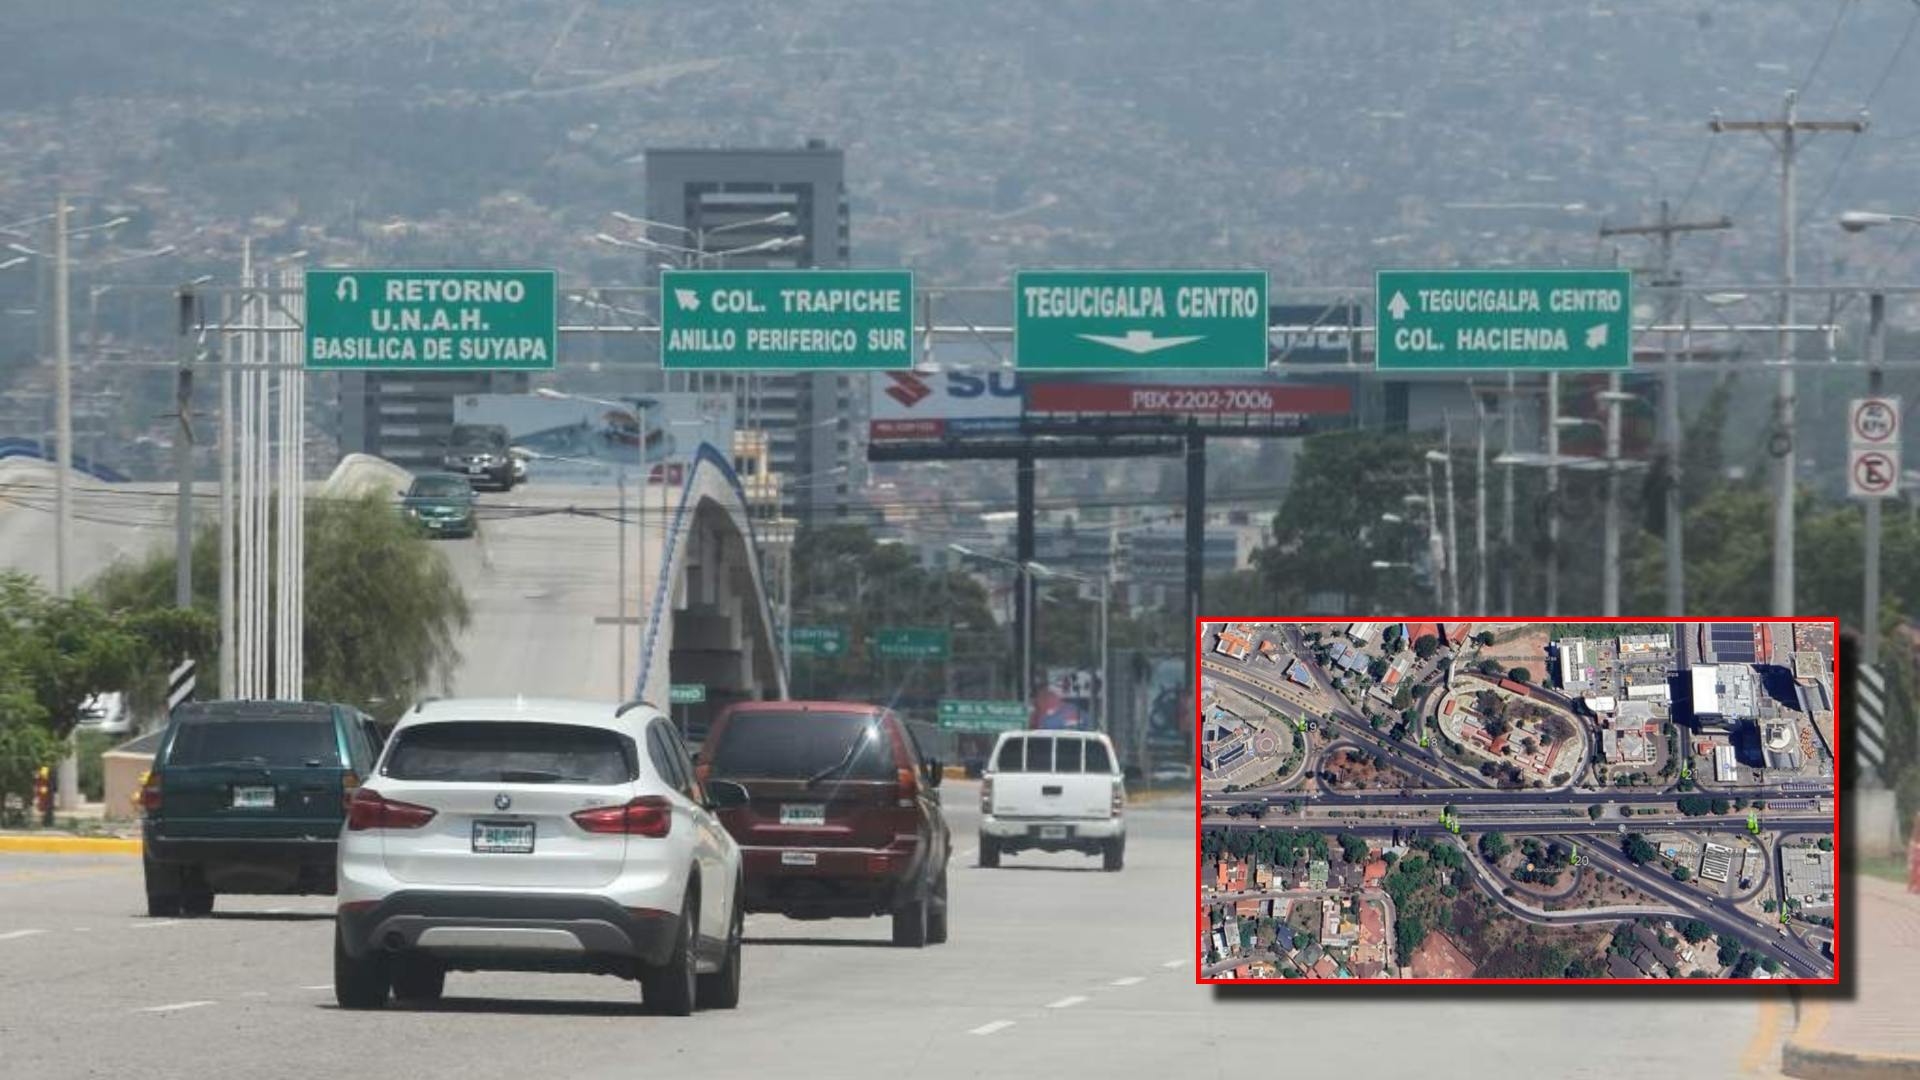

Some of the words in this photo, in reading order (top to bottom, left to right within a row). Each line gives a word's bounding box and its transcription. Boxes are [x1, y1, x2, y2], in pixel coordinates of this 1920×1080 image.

[386, 279, 525, 303] RETORNO
[711, 289, 767, 313] COL.
[780, 289, 902, 313] TRAPICHE
[1024, 286, 1167, 318] TEGUCIGALPA
[1176, 286, 1259, 318] CENTRO
[1418, 289, 1540, 313] TEGUCIGALPA
[1549, 288, 1622, 312] CENTRO
[371, 308, 490, 332] U.N.A.H.
[312, 337, 417, 360] BASILICA
[423, 338, 452, 360] DE
[459, 337, 547, 361] SUYAPA
[668, 328, 736, 351] ANILLO
[746, 328, 857, 352] PERIFERICO
[867, 328, 907, 351] SUR
[1394, 328, 1445, 351] COL.
[1457, 327, 1569, 351] HACIENDA
[1132, 391, 1170, 409] PBX
[1174, 391, 1273, 409] 2202-7006
